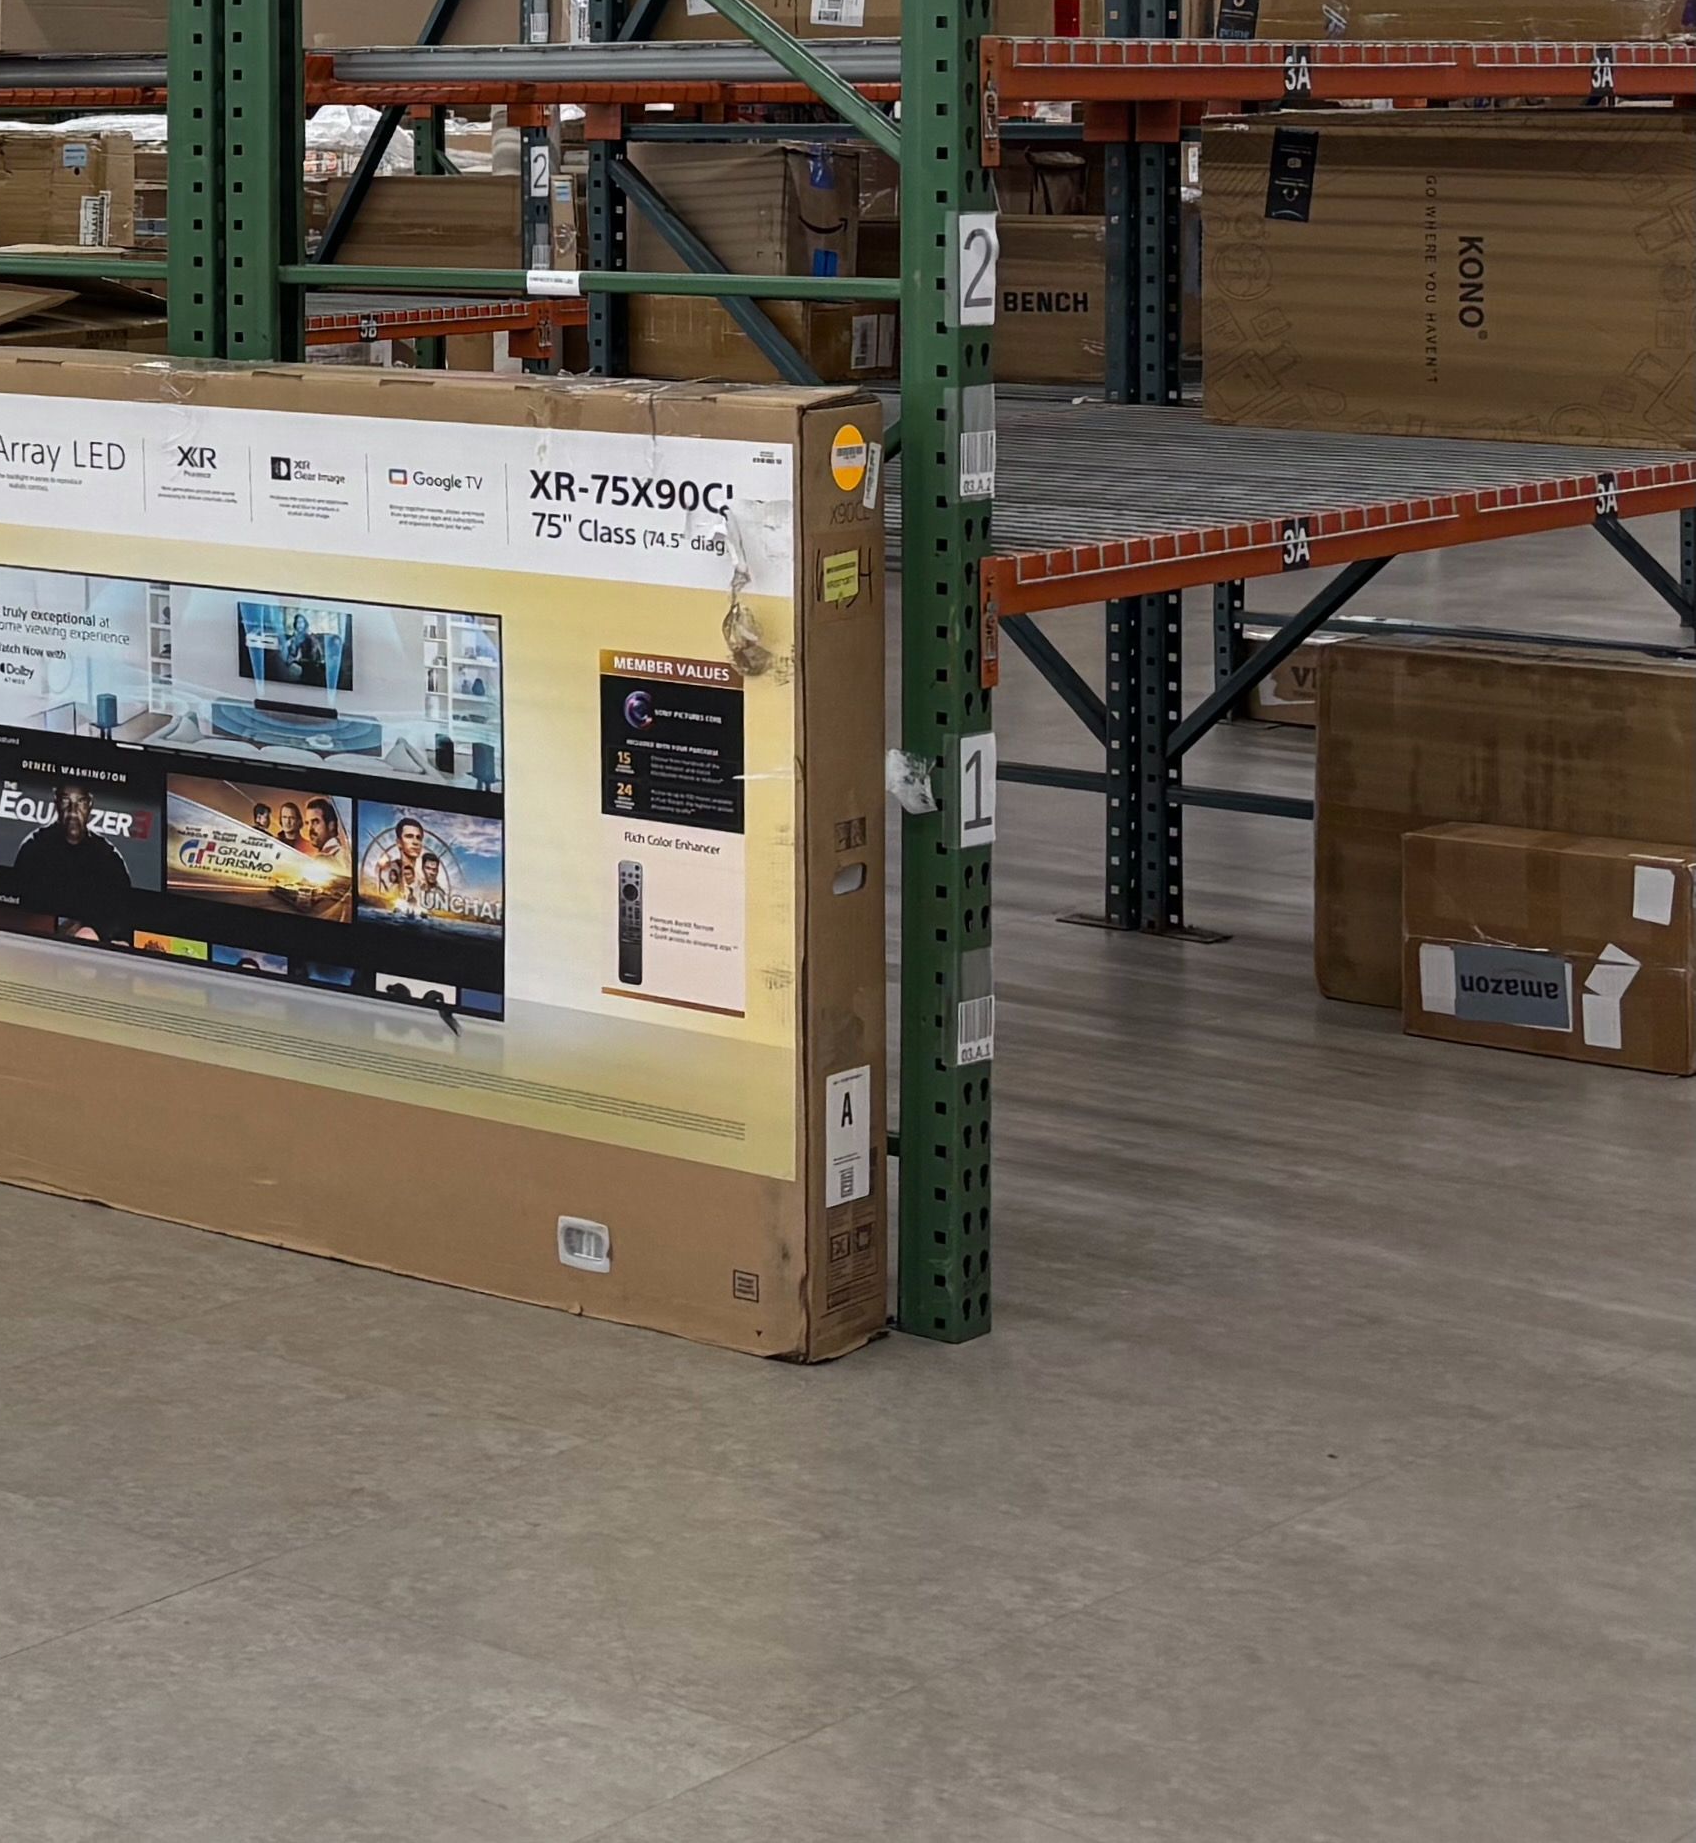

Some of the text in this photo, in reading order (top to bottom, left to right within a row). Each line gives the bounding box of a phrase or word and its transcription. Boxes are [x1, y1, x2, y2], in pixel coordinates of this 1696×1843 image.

[1219, 26, 1250, 41] prime
[1284, 55, 1311, 91] 3A
[1591, 57, 1614, 90] 3A
[532, 152, 548, 189] 2
[963, 228, 993, 308] 2
[1425, 174, 1438, 384] GO WHERE YOU HAVEN'T
[1002, 291, 1089, 313] BENCH
[72, 440, 126, 470] LED
[294, 471, 346, 485] Clear Image
[413, 470, 483, 491] Google TV
[962, 476, 993, 494] 03.A.2
[1596, 481, 1618, 515] 3A
[531, 512, 573, 539] 75"
[578, 519, 637, 546] Class
[1283, 528, 1311, 565] 3A
[2, 605, 28, 621] truly
[31, 609, 96, 627] exceptional
[98, 617, 110, 629] at
[25, 624, 67, 641] viewing
[69, 629, 130, 646] experience
[22, 645, 44, 658] Now
[46, 648, 67, 660] with
[6, 663, 34, 680] Dolby
[614, 656, 730, 681] MEMBER VALUES
[618, 751, 631, 764] 15
[21, 759, 127, 783] DENZEL WASHINGTON
[617, 783, 633, 796] 24
[963, 748, 993, 830] 1
[217, 846, 261, 860] GRAN
[624, 831, 720, 855] Rich Color Enhancer
[207, 854, 274, 873] TURISMO
[1459, 973, 1559, 1001] amazon
[960, 1044, 992, 1064] 03.A.1
[840, 1092, 854, 1128] A
